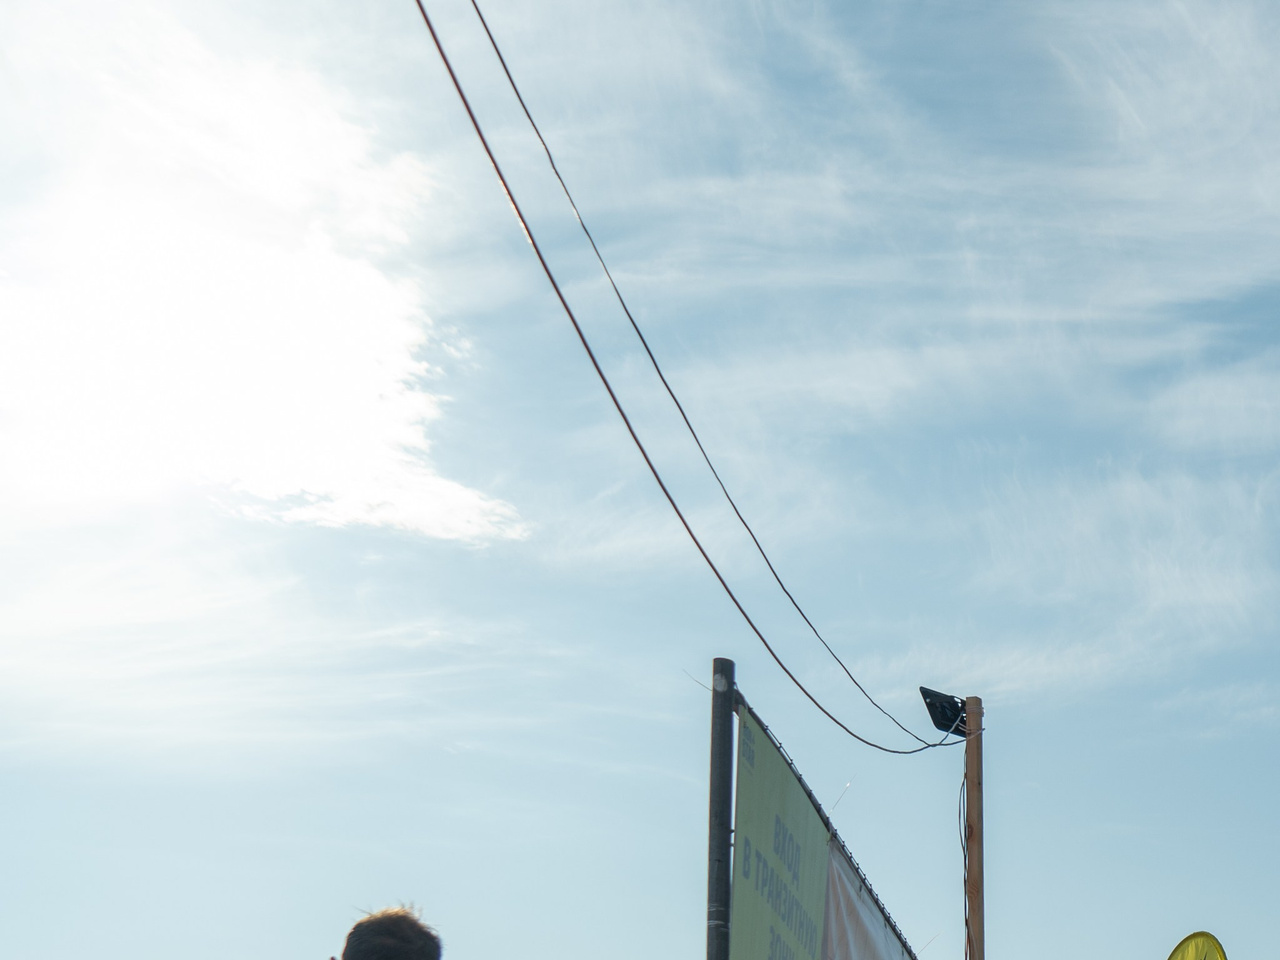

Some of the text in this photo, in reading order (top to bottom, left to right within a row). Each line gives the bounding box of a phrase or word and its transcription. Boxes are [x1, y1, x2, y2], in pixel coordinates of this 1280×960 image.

[742, 835, 818, 960] В ТРАНЗИТНУЮ
[773, 814, 801, 892] ВХОД
